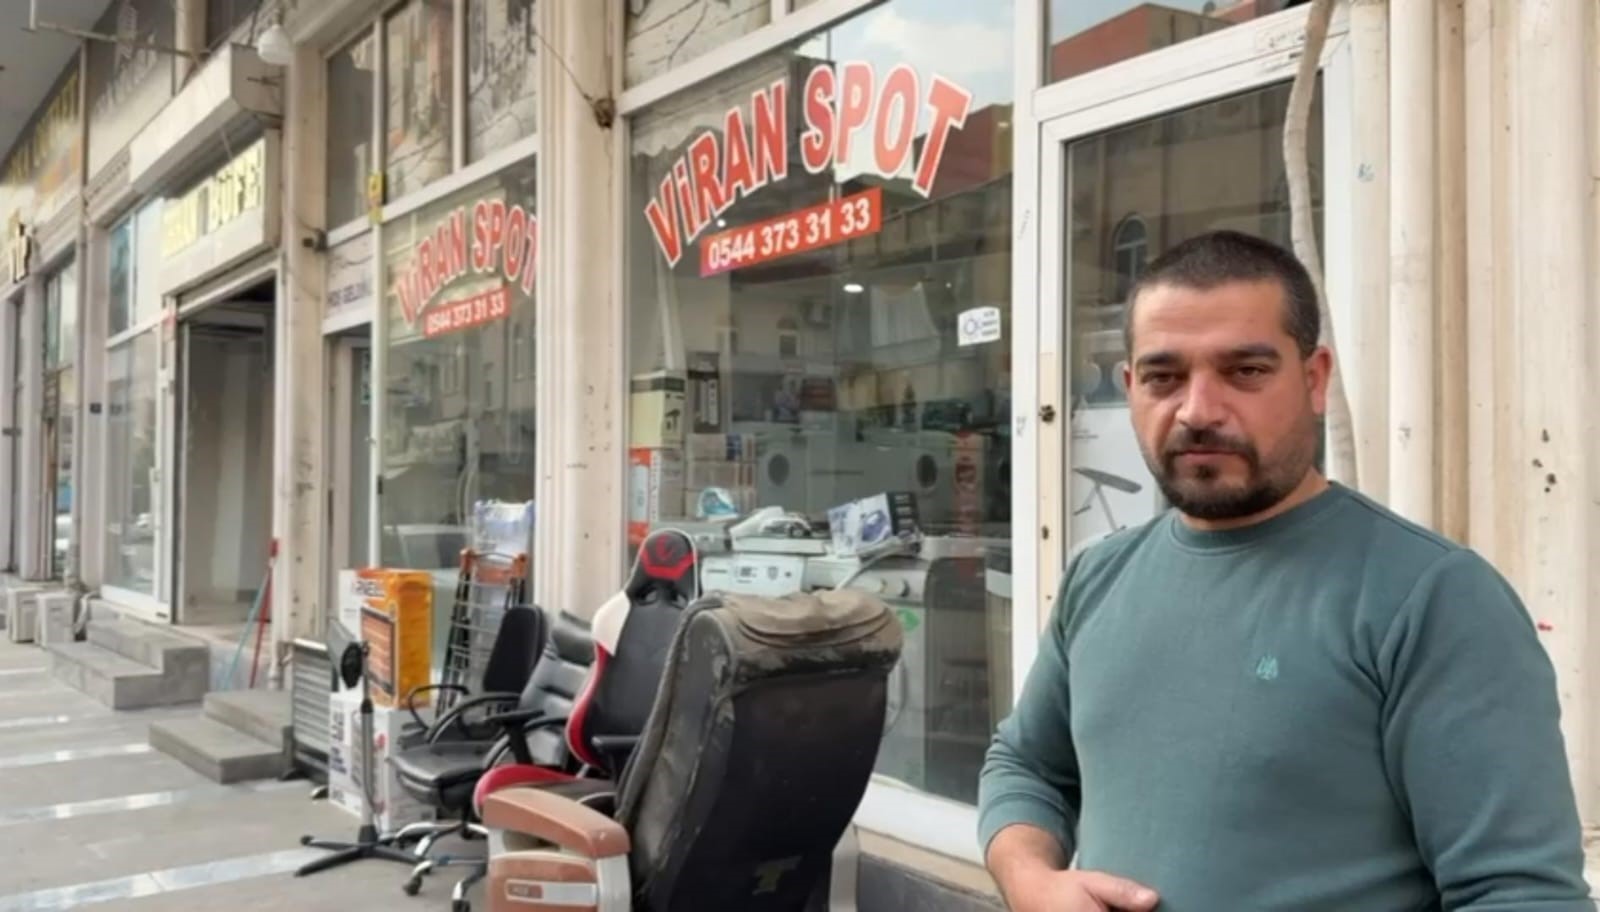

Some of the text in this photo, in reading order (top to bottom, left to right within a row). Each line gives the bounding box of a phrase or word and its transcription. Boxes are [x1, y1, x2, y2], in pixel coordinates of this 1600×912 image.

[801, 61, 972, 198] SPOT
[708, 197, 871, 269] 0544 373 31 33
[489, 291, 506, 317] 33
